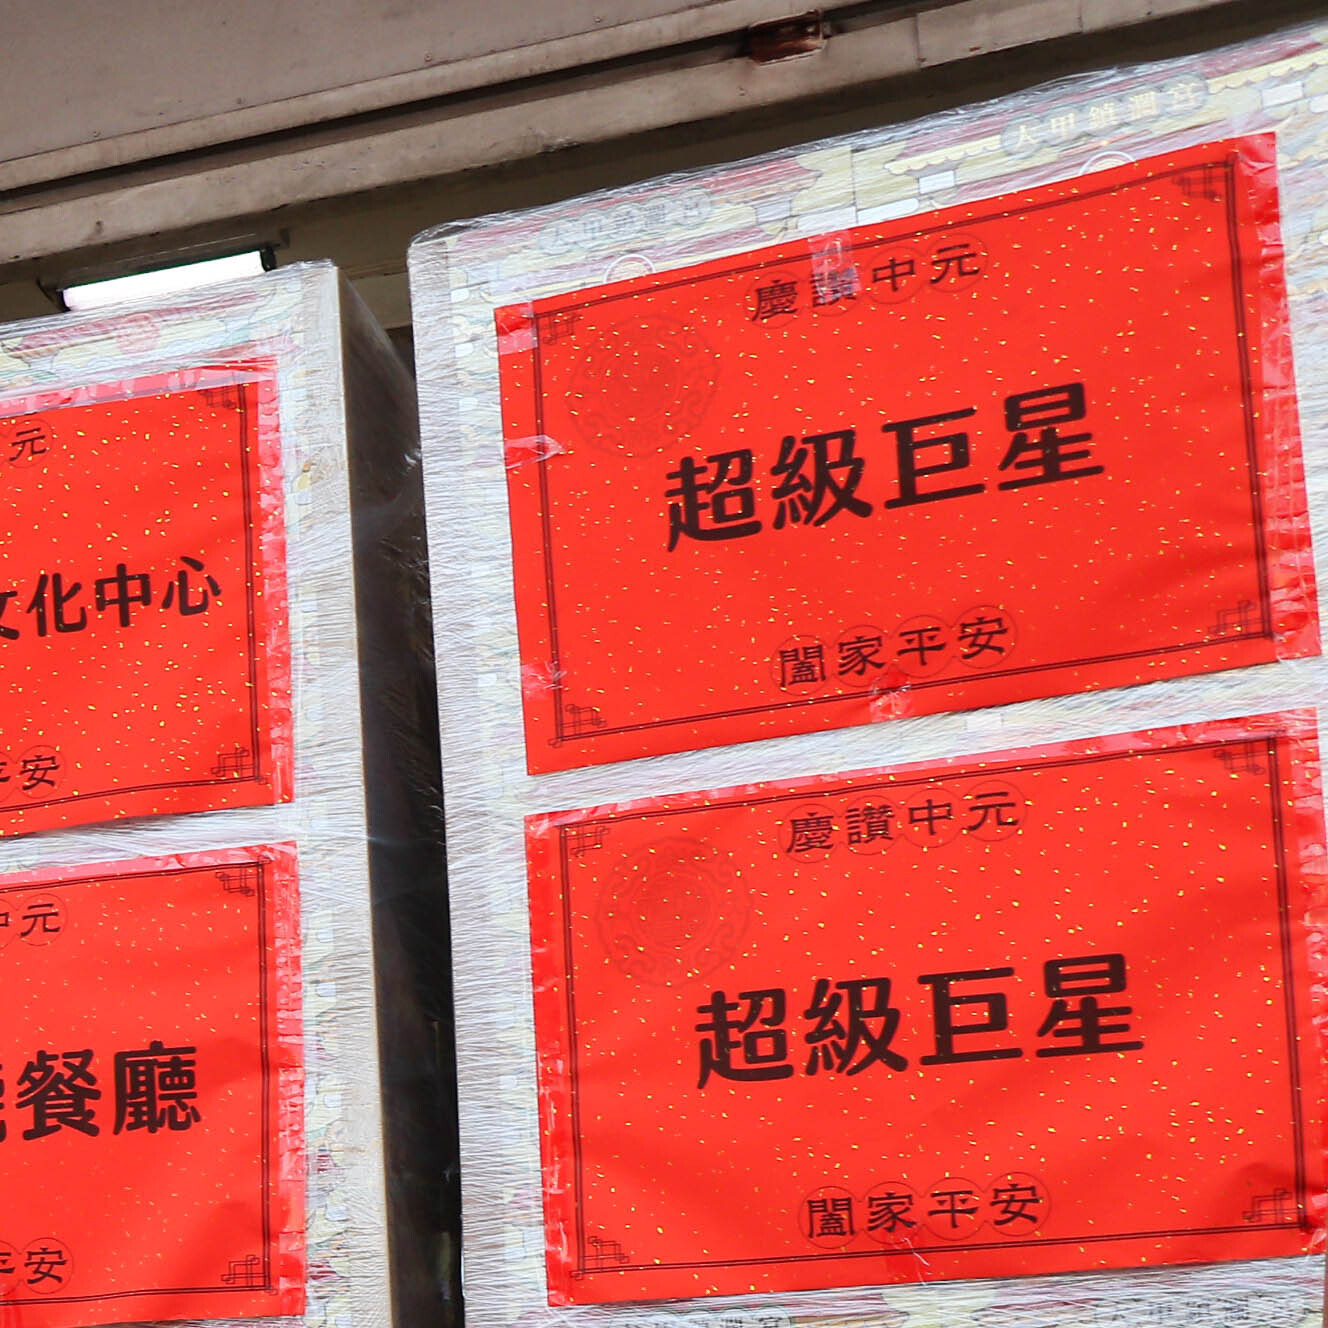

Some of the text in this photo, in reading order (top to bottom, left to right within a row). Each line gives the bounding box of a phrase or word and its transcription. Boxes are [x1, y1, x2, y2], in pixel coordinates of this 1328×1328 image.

[666, 383, 1104, 552] 超級巨星
[787, 792, 1018, 852] 慶讚中元
[696, 954, 1144, 1089] 超級巨星
